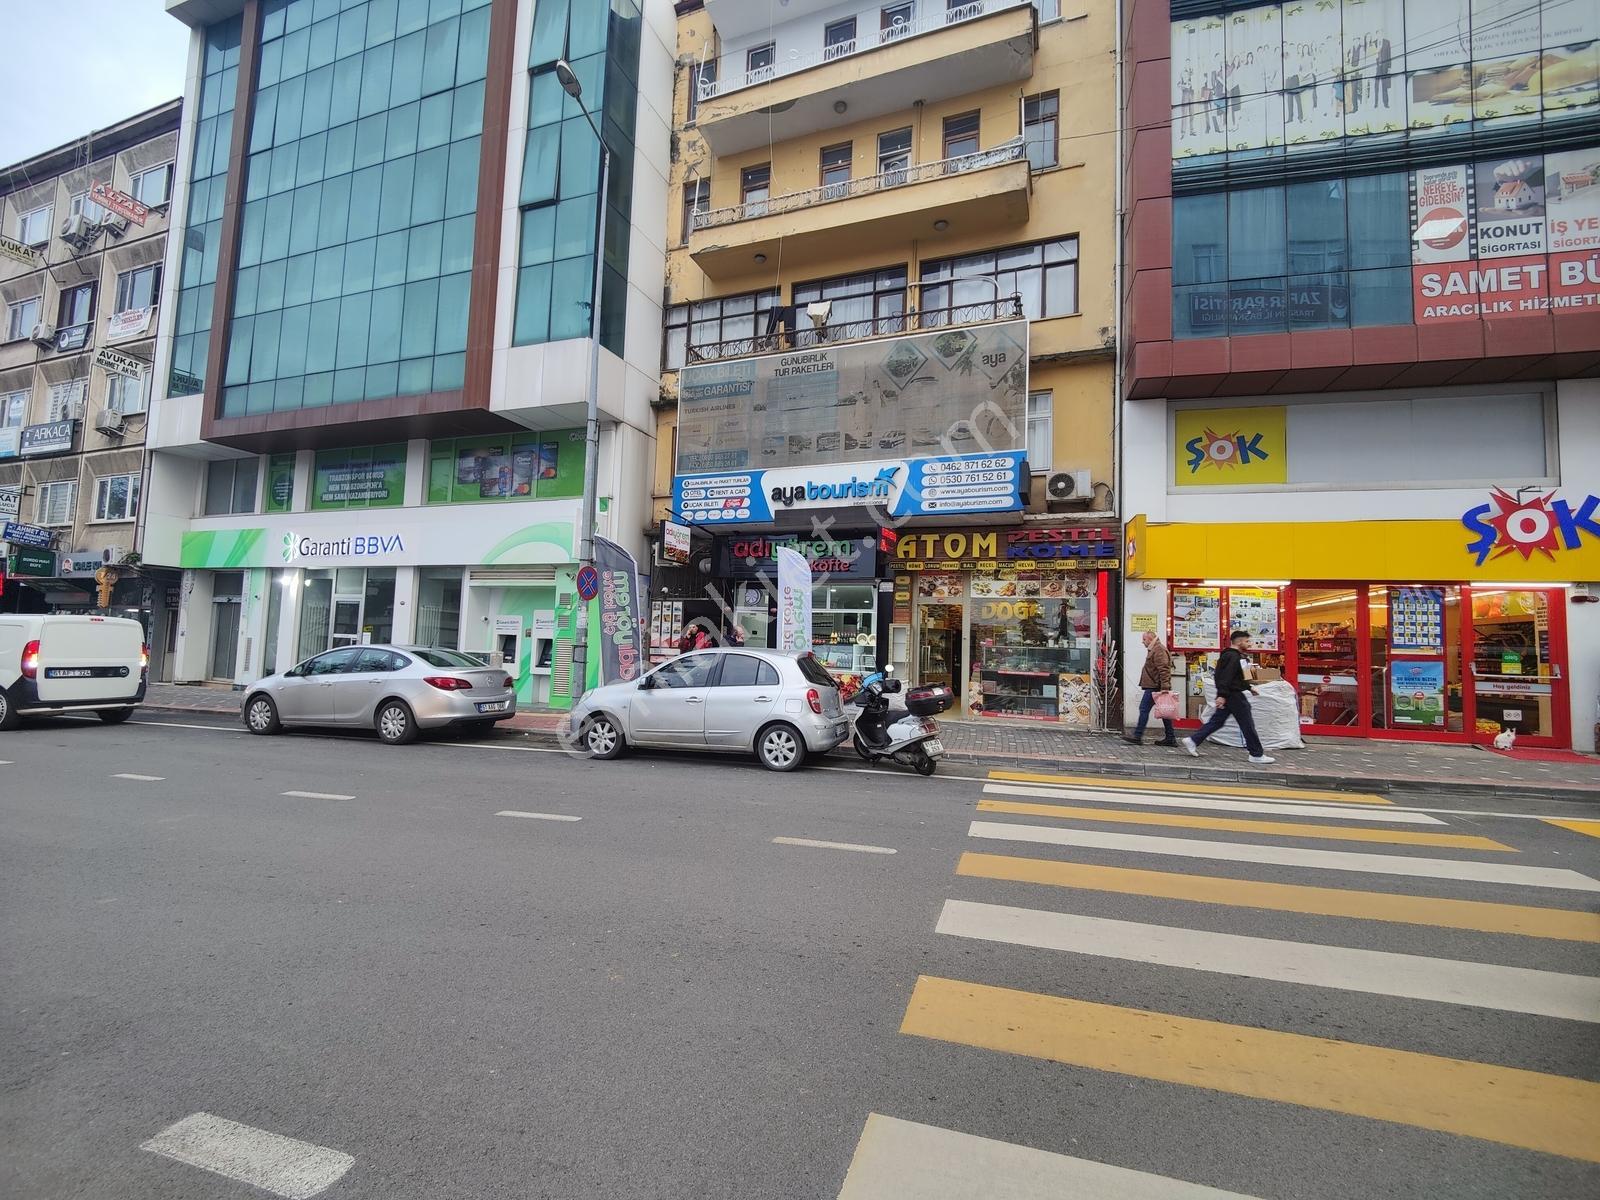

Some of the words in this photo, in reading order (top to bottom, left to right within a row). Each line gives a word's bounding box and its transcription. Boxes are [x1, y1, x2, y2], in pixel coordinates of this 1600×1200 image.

[1423, 181, 1457, 196] NEREYE
[1480, 222, 1543, 239] KONUT
[1551, 219, 1567, 236] İŞ
[1480, 241, 1541, 253] SİGORTASI
[1420, 264, 1547, 298] SAMET
[1423, 300, 1513, 318] ARACILIK
[96, 357, 120, 373] MEHMET
[121, 366, 139, 378] AKYOL
[99, 350, 140, 370] AVUKAT
[781, 353, 828, 366] GÜNÜBİRLİK
[982, 352, 1006, 369] aya
[774, 368, 790, 377] TUR
[791, 362, 835, 375] PAKETLERİ
[1186, 432, 1269, 473] ŞOK
[940, 462, 961, 472] 0462
[964, 461, 979, 470] 871
[981, 459, 993, 469] 62
[994, 458, 1007, 468] 62
[940, 475, 962, 484] 0530
[965, 474, 980, 483] 761
[982, 473, 993, 481] 52
[996, 472, 1006, 480] 61
[1462, 494, 1600, 567] ŞOK
[299, 536, 351, 558] Garanti
[354, 532, 404, 555] BBVA
[896, 533, 997, 558] ATOM
